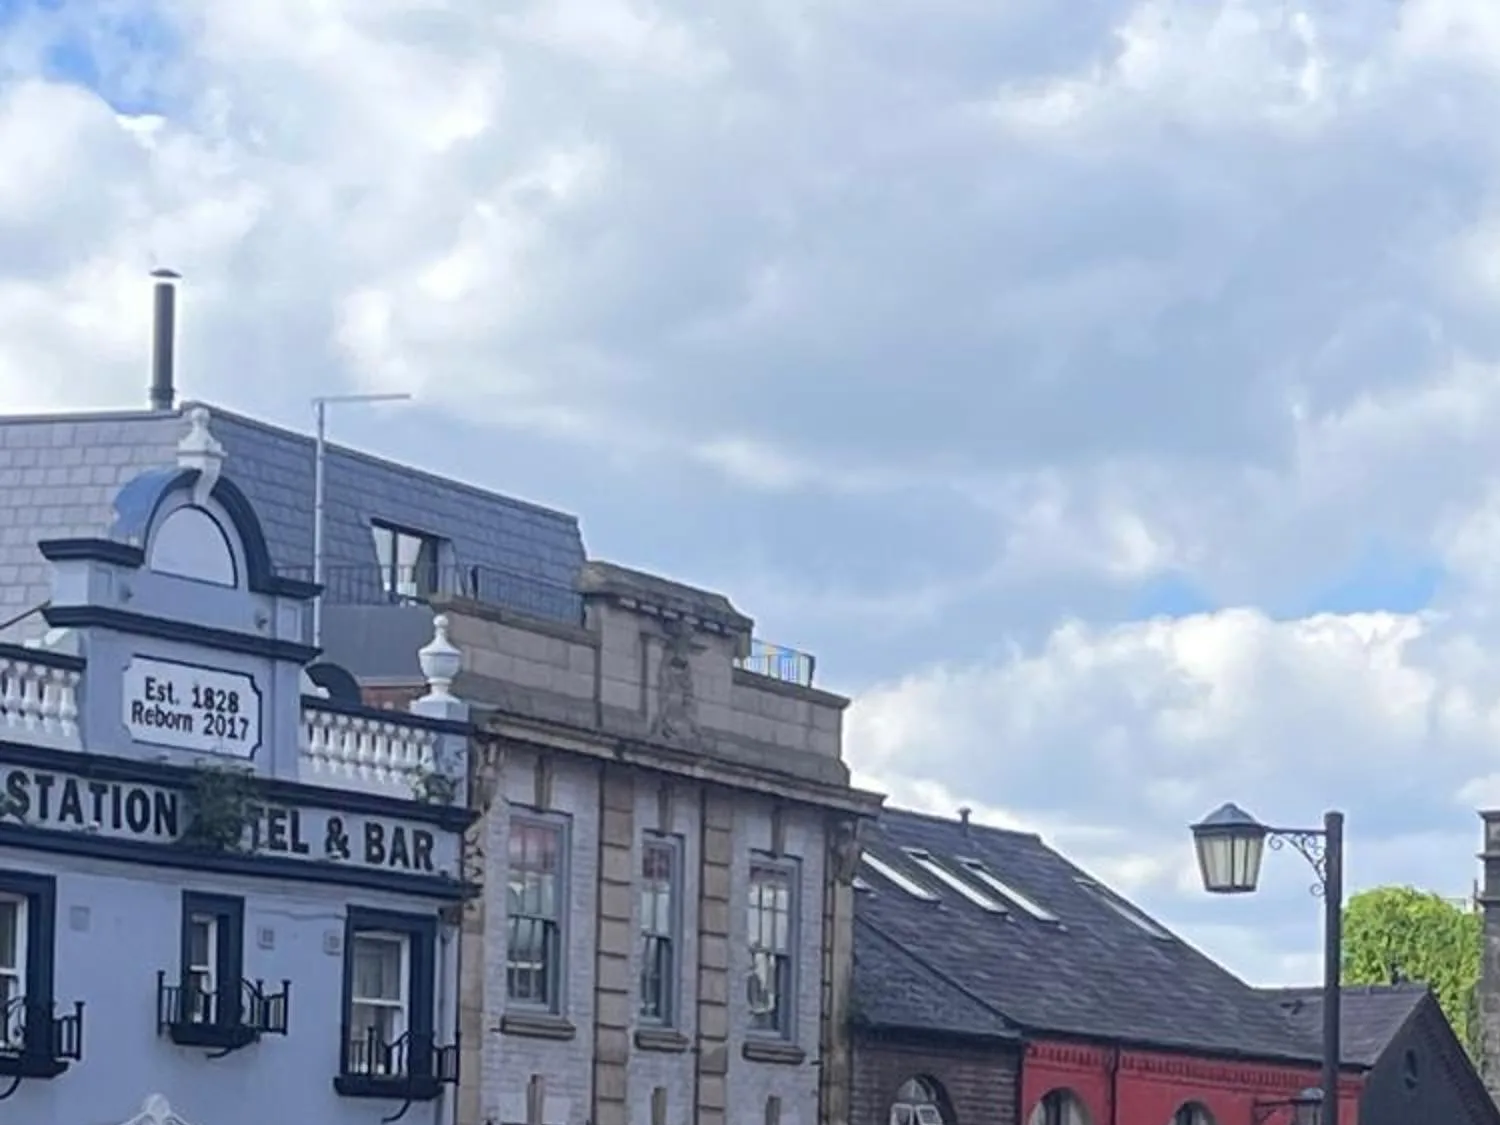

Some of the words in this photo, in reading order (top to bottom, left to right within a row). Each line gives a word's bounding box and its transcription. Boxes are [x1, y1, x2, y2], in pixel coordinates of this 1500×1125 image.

[145, 676, 180, 705] Est.
[192, 684, 239, 713] 1828
[132, 699, 193, 733] Reborn
[203, 712, 249, 741] 2017
[7, 769, 177, 837] STATION
[325, 817, 350, 859] &
[364, 821, 434, 872] BAR
